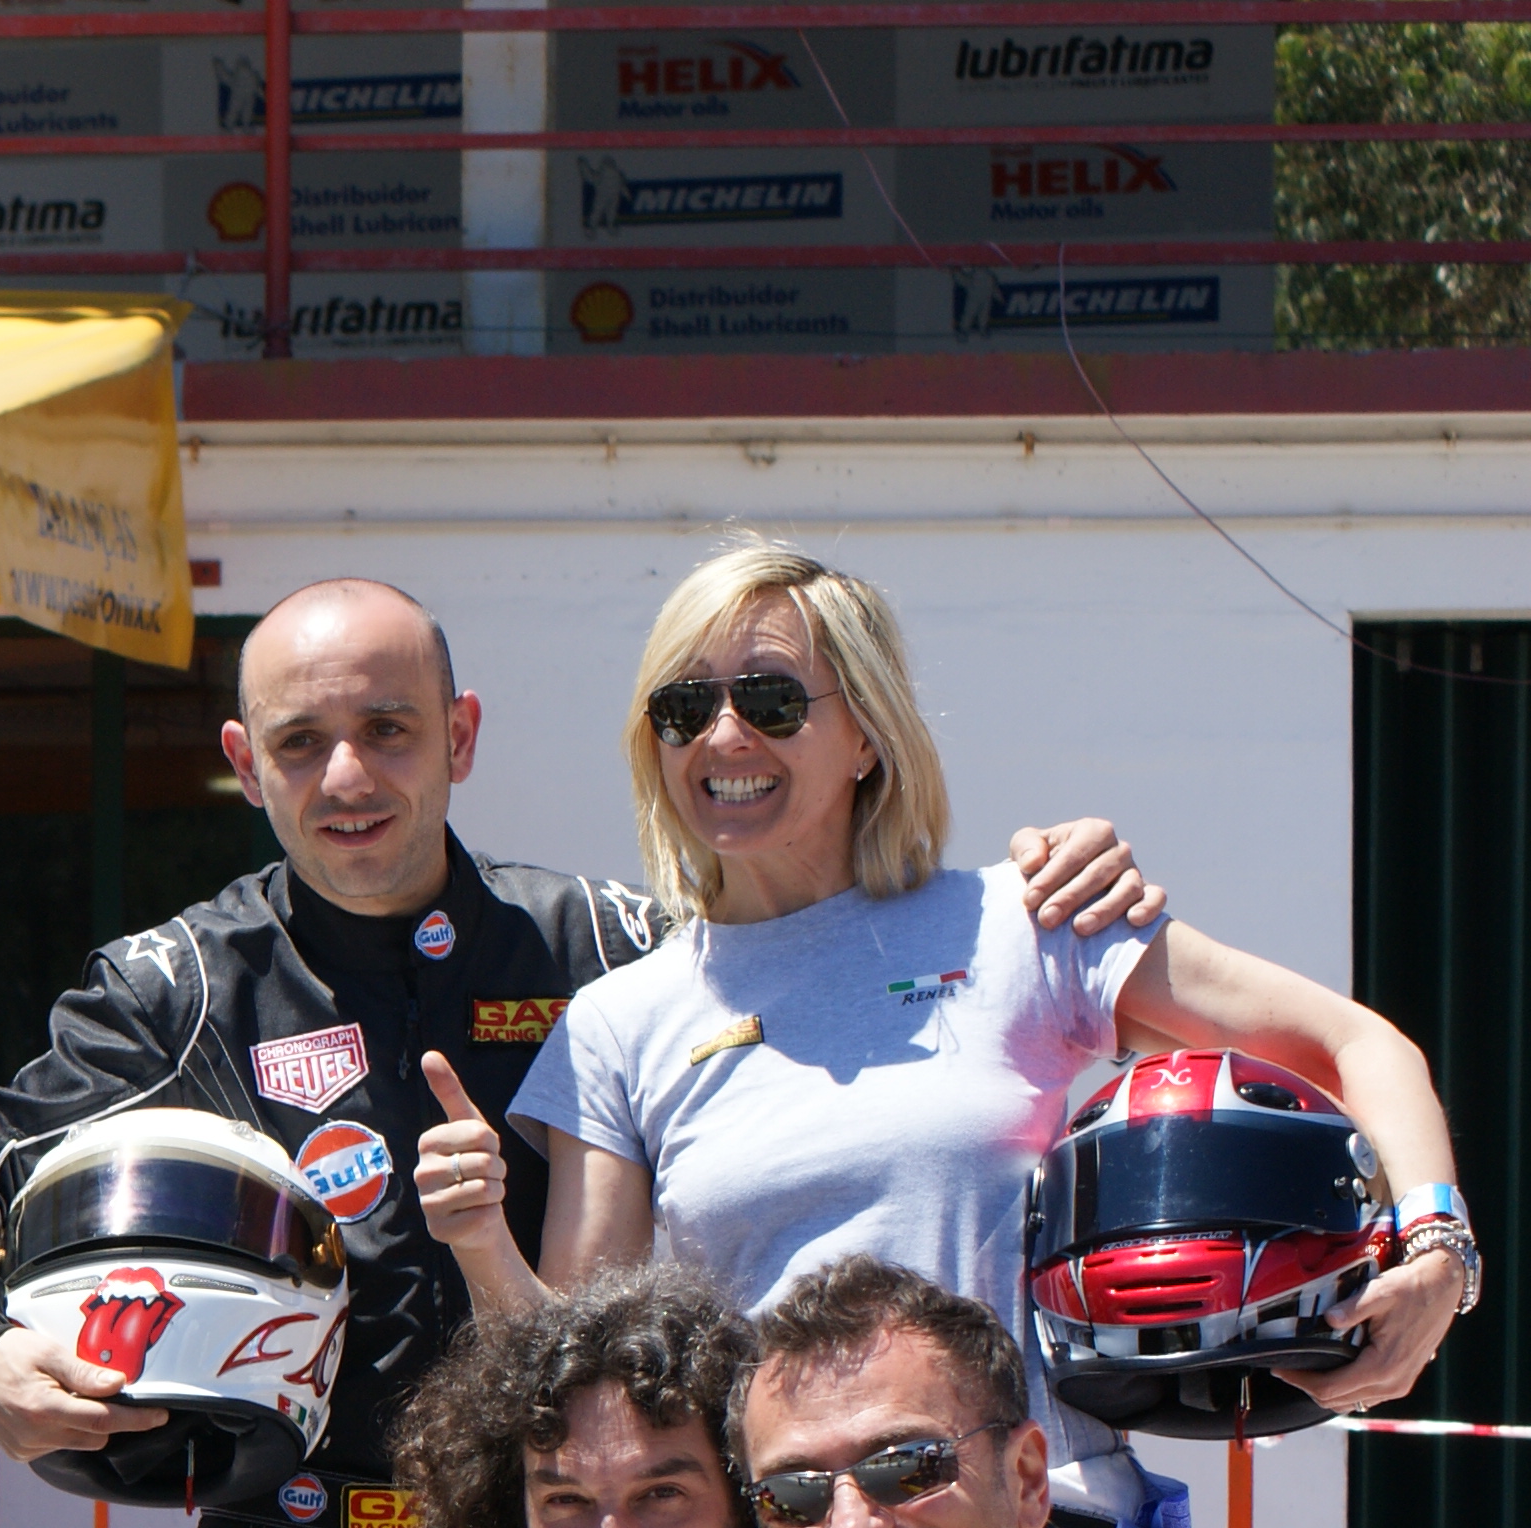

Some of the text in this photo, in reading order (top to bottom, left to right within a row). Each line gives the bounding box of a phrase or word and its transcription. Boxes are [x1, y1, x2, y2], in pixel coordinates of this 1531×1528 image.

[956, 36, 1213, 79] lubrifatima
[619, 56, 794, 95] HELIX
[619, 97, 730, 118] Motor oils
[991, 157, 1170, 197] HELIX
[633, 181, 835, 212] MICHELIN
[991, 198, 1103, 221] Motor oils
[354, 212, 460, 234] Lubrican
[651, 284, 799, 309] Distribuidor
[1005, 285, 1210, 316] MICHELIN
[651, 312, 849, 336] Shell Lubricants
[417, 924, 452, 946] Gulf
[256, 1028, 356, 1061] CHRONOGRAPH
[471, 1028, 536, 1042] RACING
[268, 1050, 356, 1101] HEUER
[305, 1141, 390, 1199] Gulf
[282, 1488, 325, 1511] Gulf
